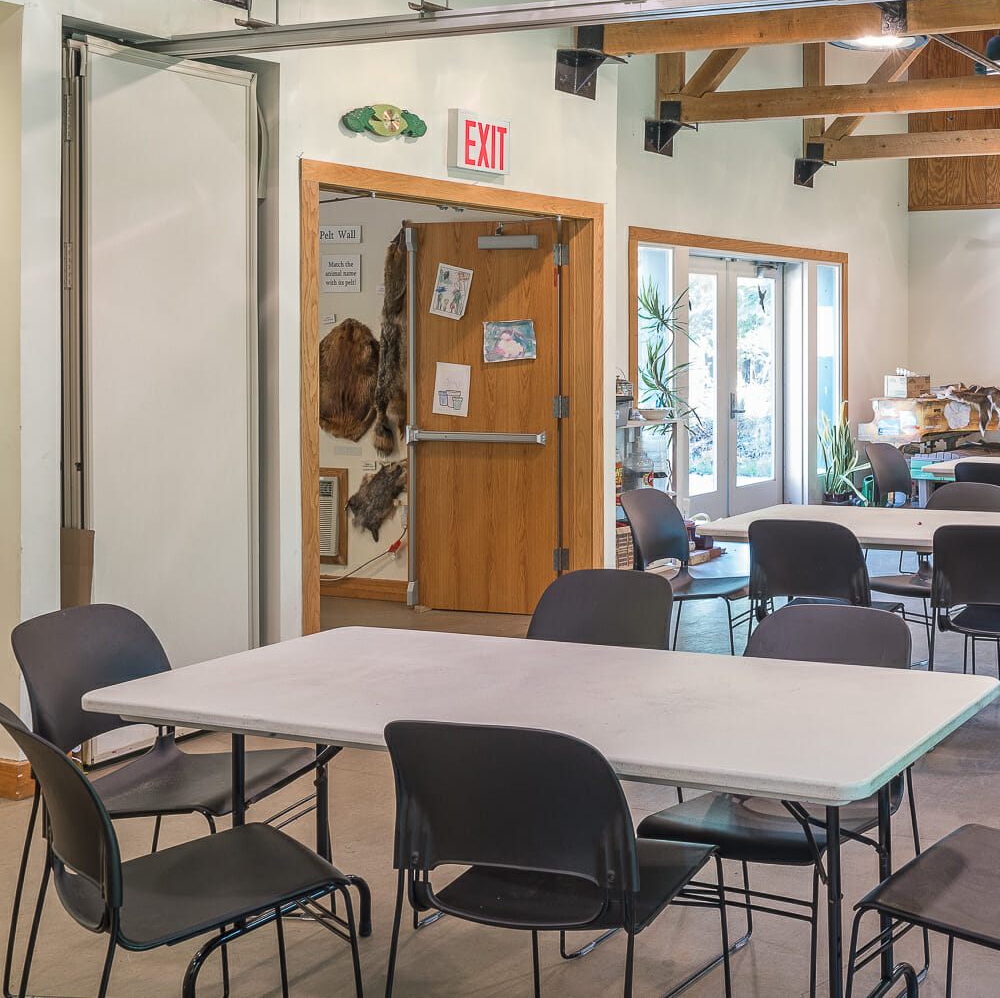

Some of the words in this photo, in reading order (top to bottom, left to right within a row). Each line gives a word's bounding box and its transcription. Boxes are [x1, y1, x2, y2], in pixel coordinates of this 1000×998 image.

[465, 119, 507, 171] EXIT
[320, 230, 334, 240] Pelt
[338, 230, 356, 239] Wall
[345, 279, 356, 287] pelt!
